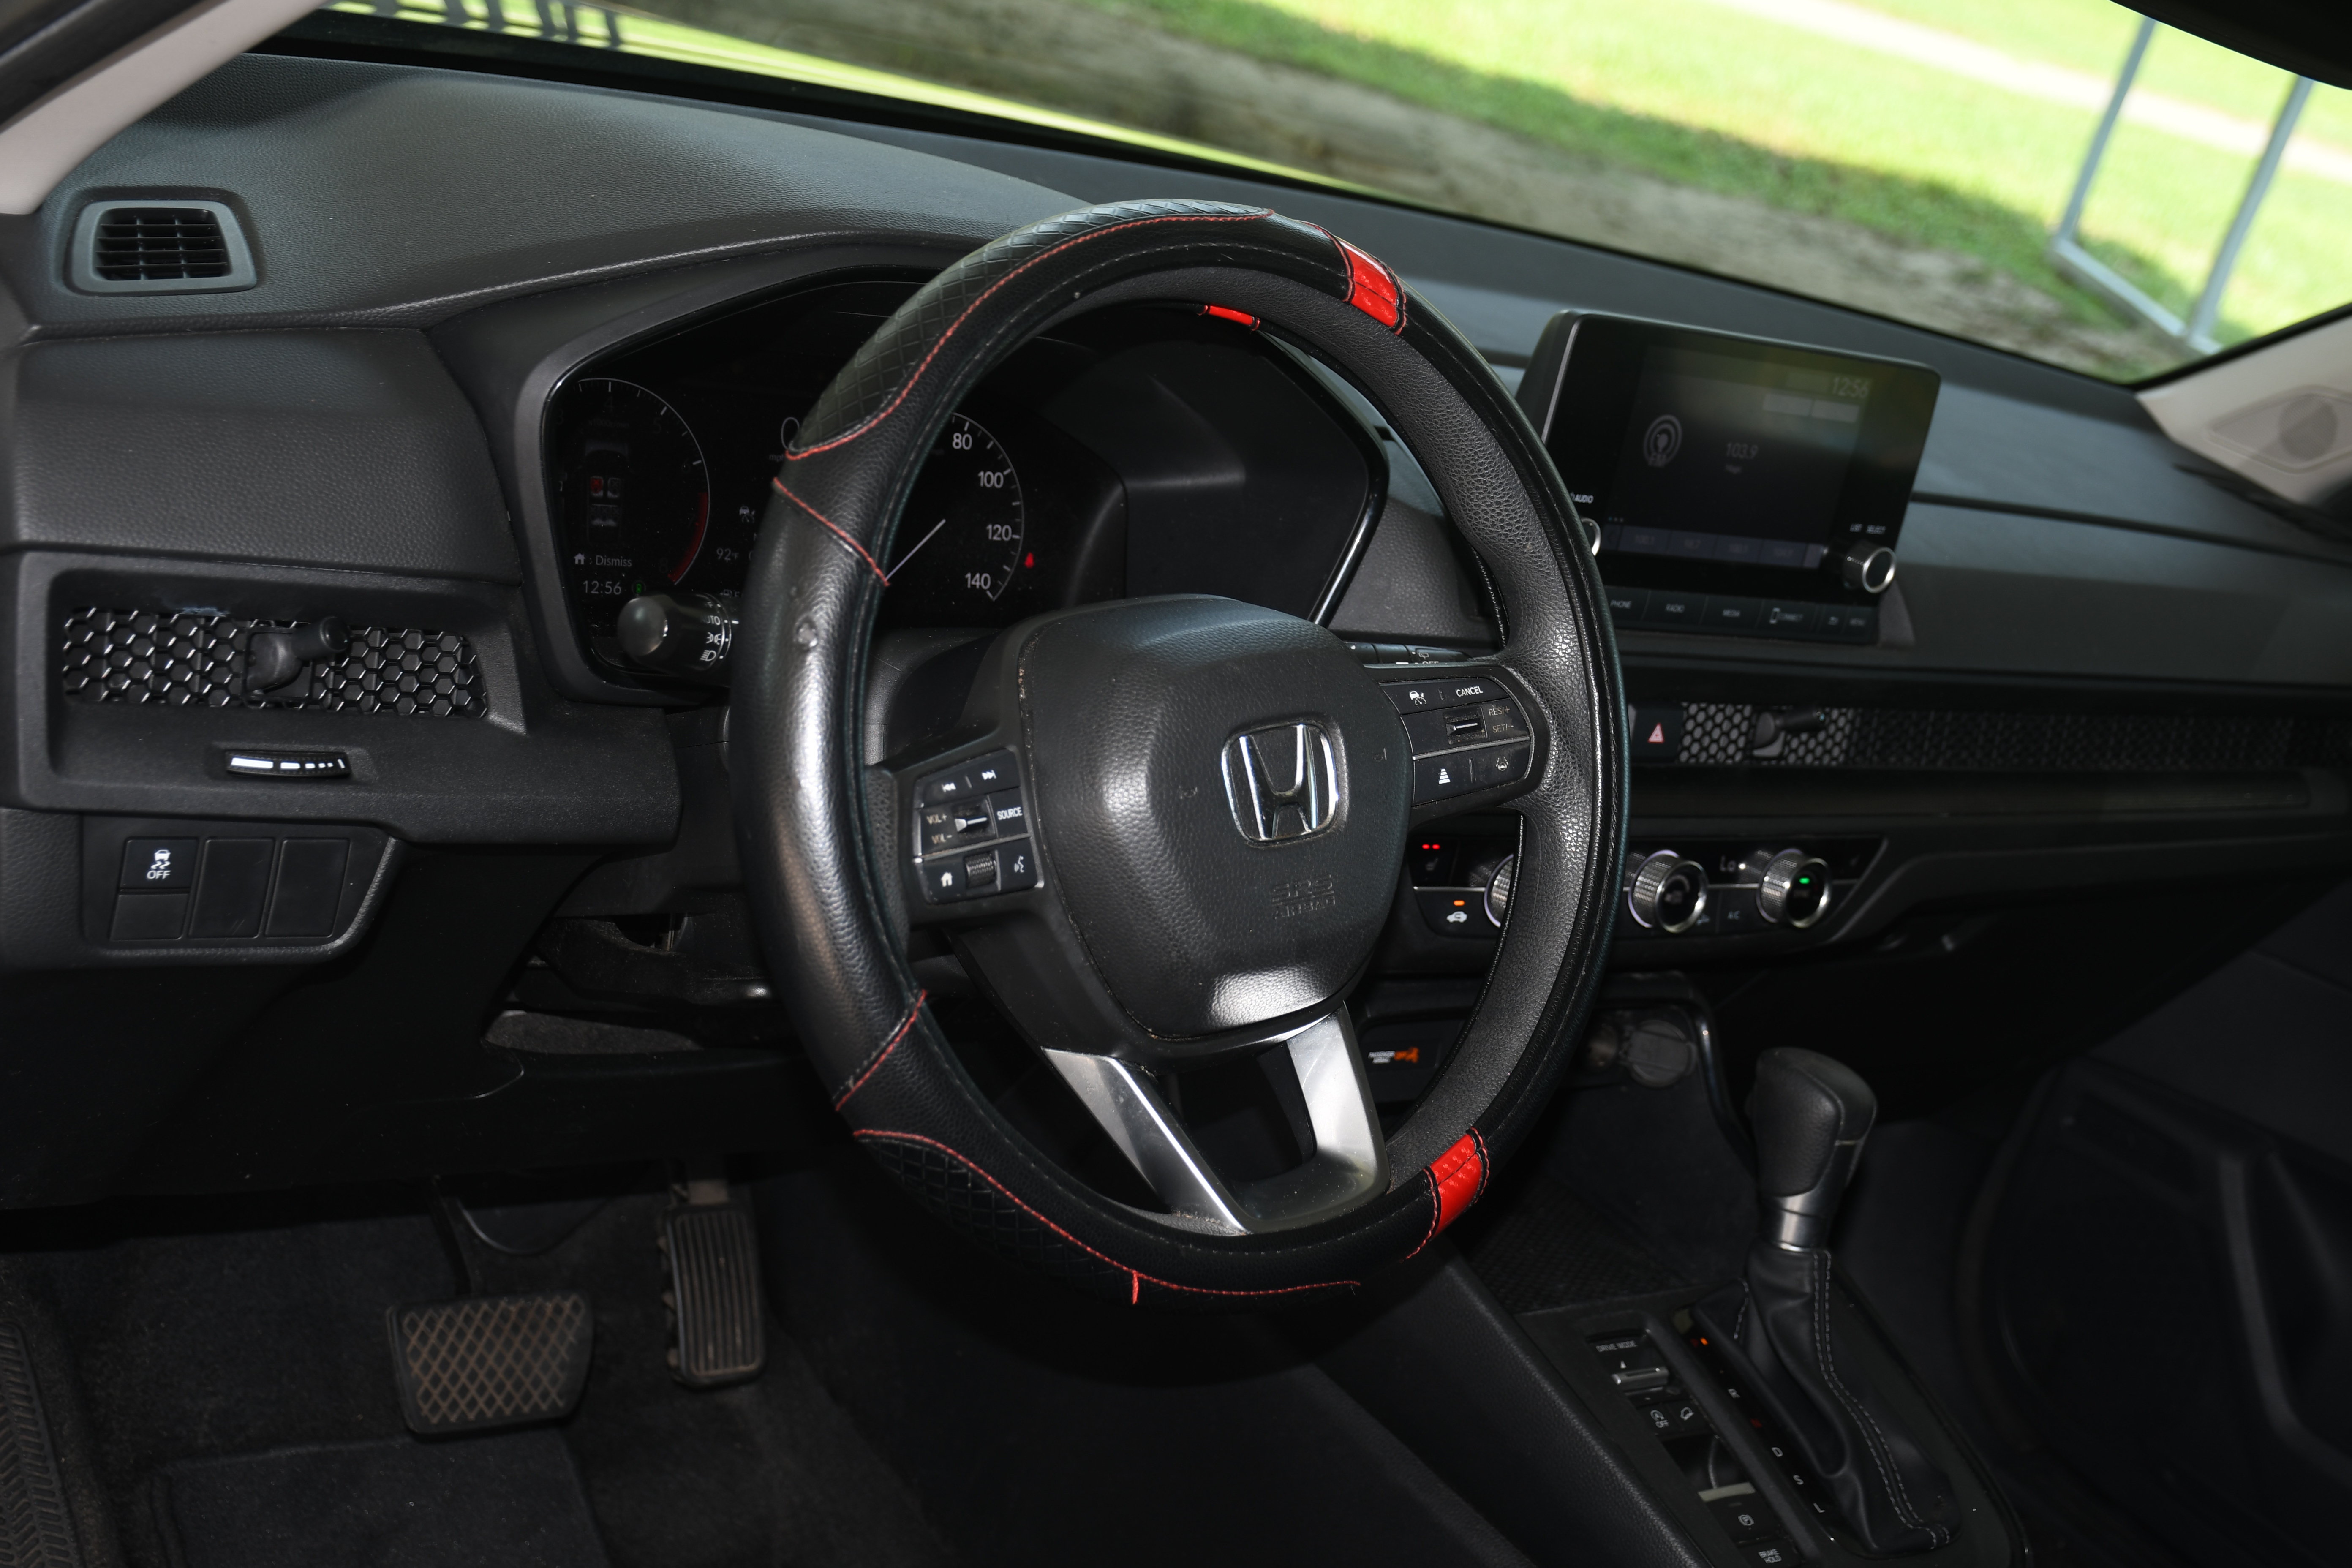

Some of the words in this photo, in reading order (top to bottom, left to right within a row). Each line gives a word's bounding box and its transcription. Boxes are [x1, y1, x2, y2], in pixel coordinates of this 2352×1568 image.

[952, 432, 973, 450] 80
[977, 470, 1004, 489] 100
[1575, 493, 1594, 504] AUDIO
[986, 523, 1013, 542] 120
[596, 555, 632, 567] Dismiss
[583, 580, 621, 595] 12:56
[965, 572, 991, 590] 140
[1456, 686, 1484, 697] CANCEL
[997, 806, 1023, 821] SOURCE
[146, 870, 172, 879] OFF
[1272, 874, 1333, 902] SRS
[1771, 1447, 1783, 1458] D
[1793, 1474, 1804, 1485] S
[1813, 1503, 1825, 1513] L
